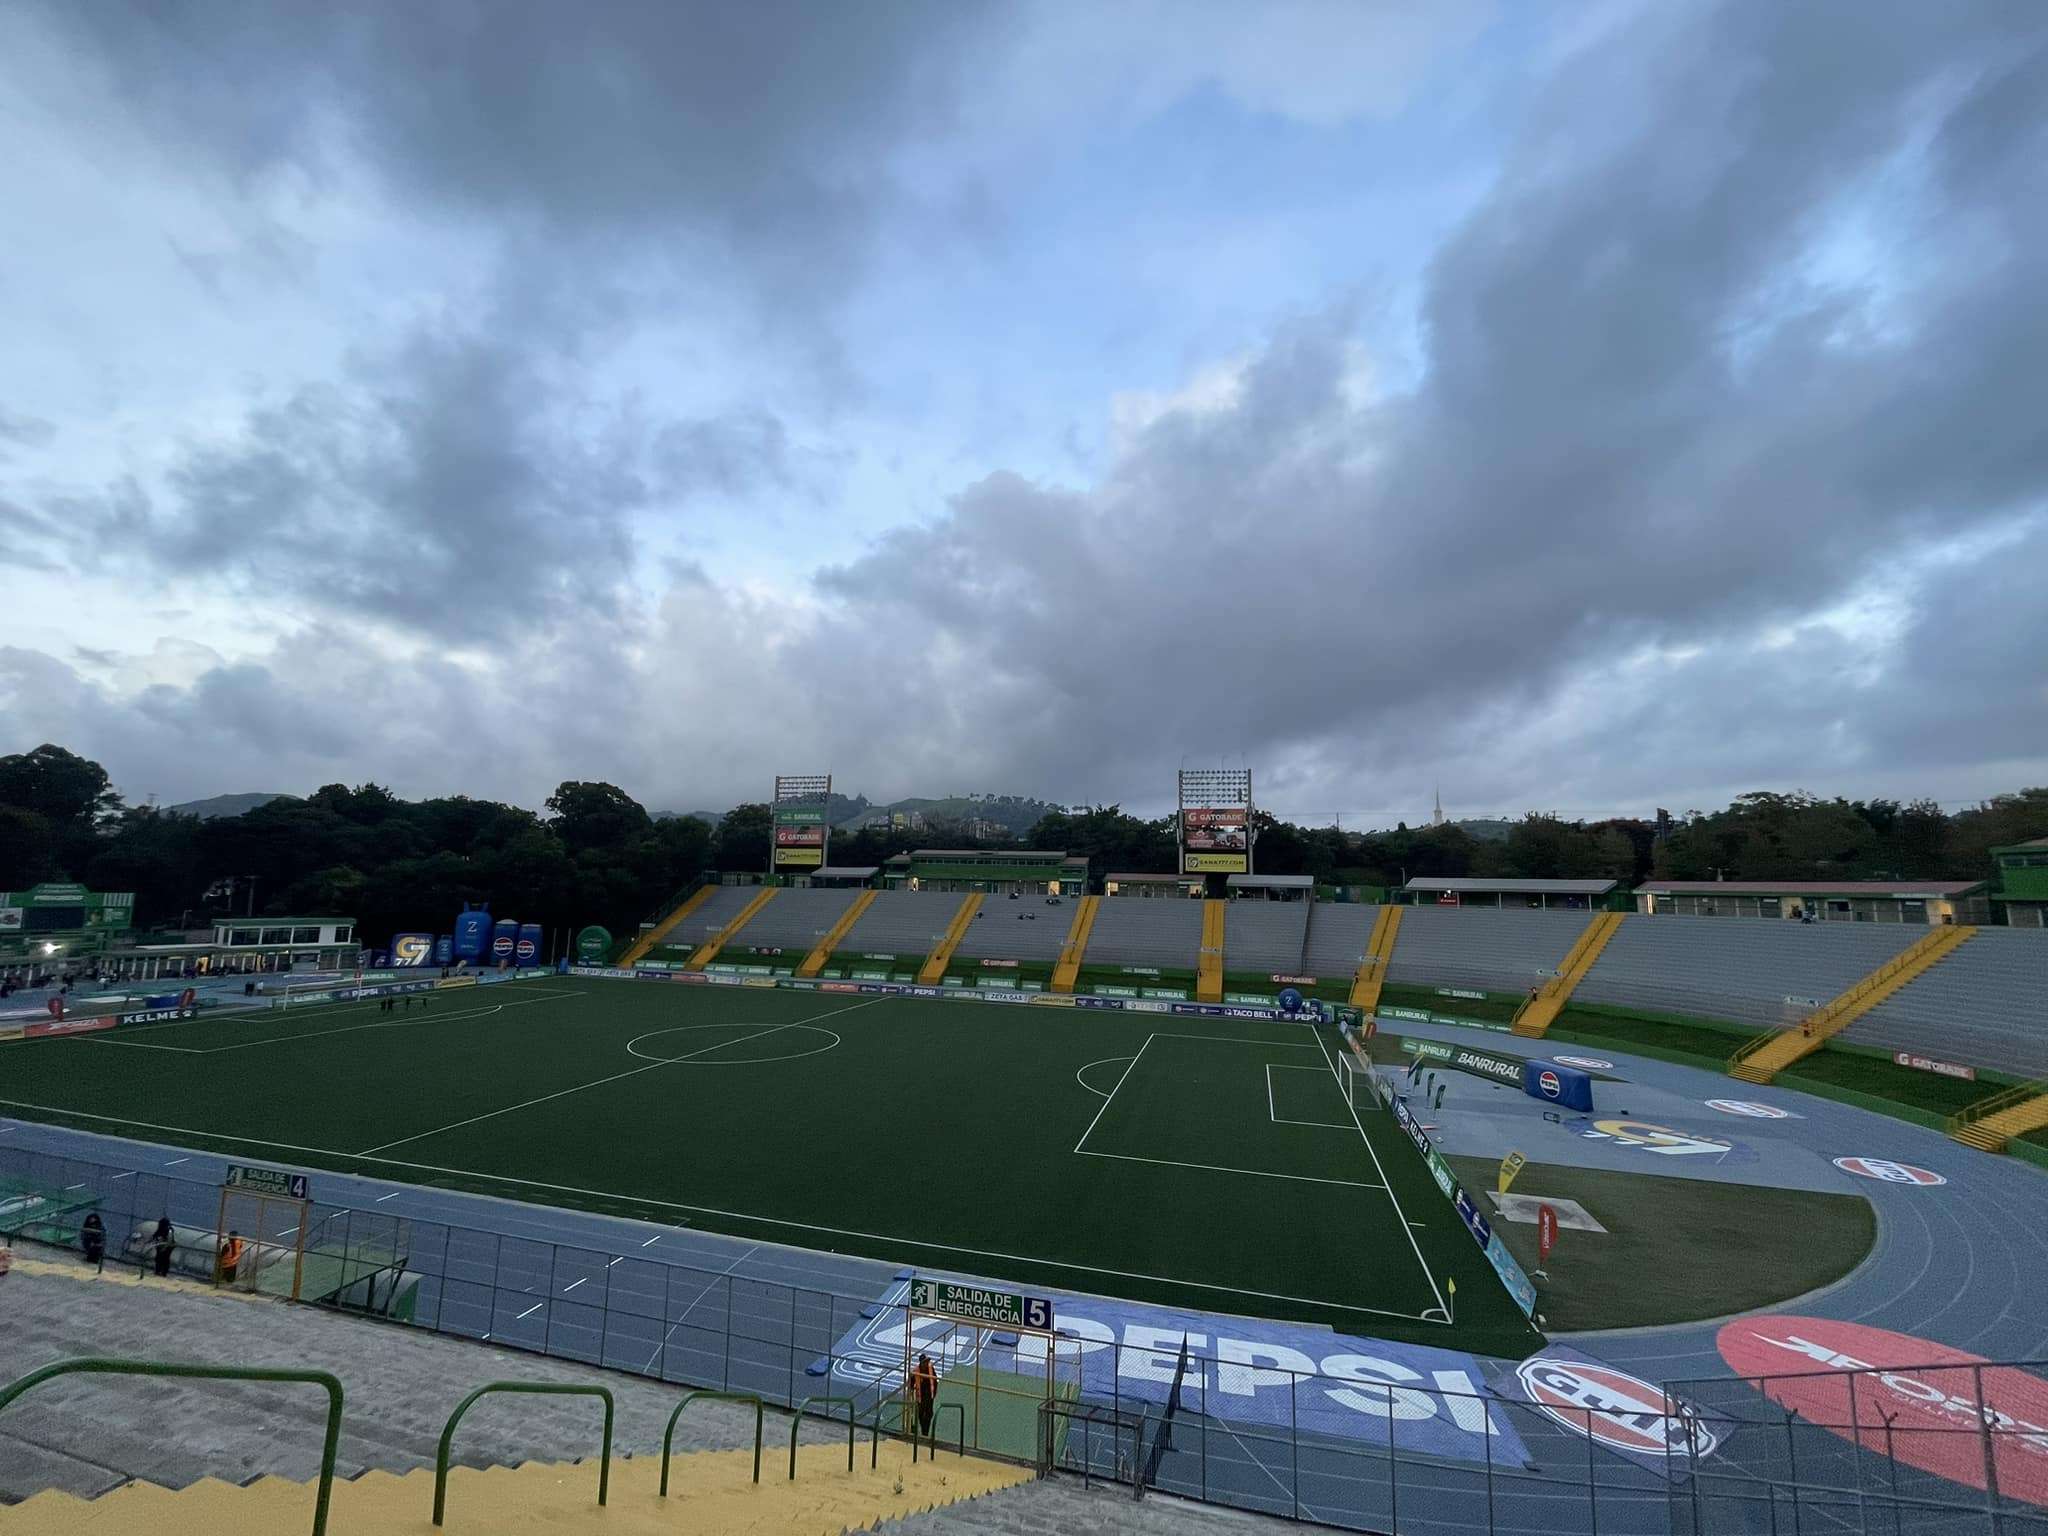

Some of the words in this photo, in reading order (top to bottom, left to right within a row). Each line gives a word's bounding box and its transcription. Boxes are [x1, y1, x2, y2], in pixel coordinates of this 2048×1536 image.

[1200, 814, 1243, 822] GATORADE
[788, 833, 819, 841] GATORADE
[467, 921, 478, 933] Z
[352, 988, 378, 997] PEPSI
[914, 988, 936, 996] PEPSI
[123, 1010, 180, 1024] KELME
[1233, 1009, 1252, 1018] TACO
[1254, 1010, 1272, 1019] BELL
[1395, 1010, 1428, 1020] BANRURAL
[1419, 1043, 1451, 1058] BANRURA
[1457, 1052, 1520, 1080] BANRURAL
[1541, 1079, 1559, 1091] PEPSI
[293, 1177, 303, 1197] 4
[947, 1287, 991, 1304] SALIDA
[994, 1295, 1012, 1308] DE
[938, 1299, 1021, 1324] EMERGENCIA
[1029, 1301, 1045, 1326] 5
[1012, 1314, 1500, 1435] PEPSI
